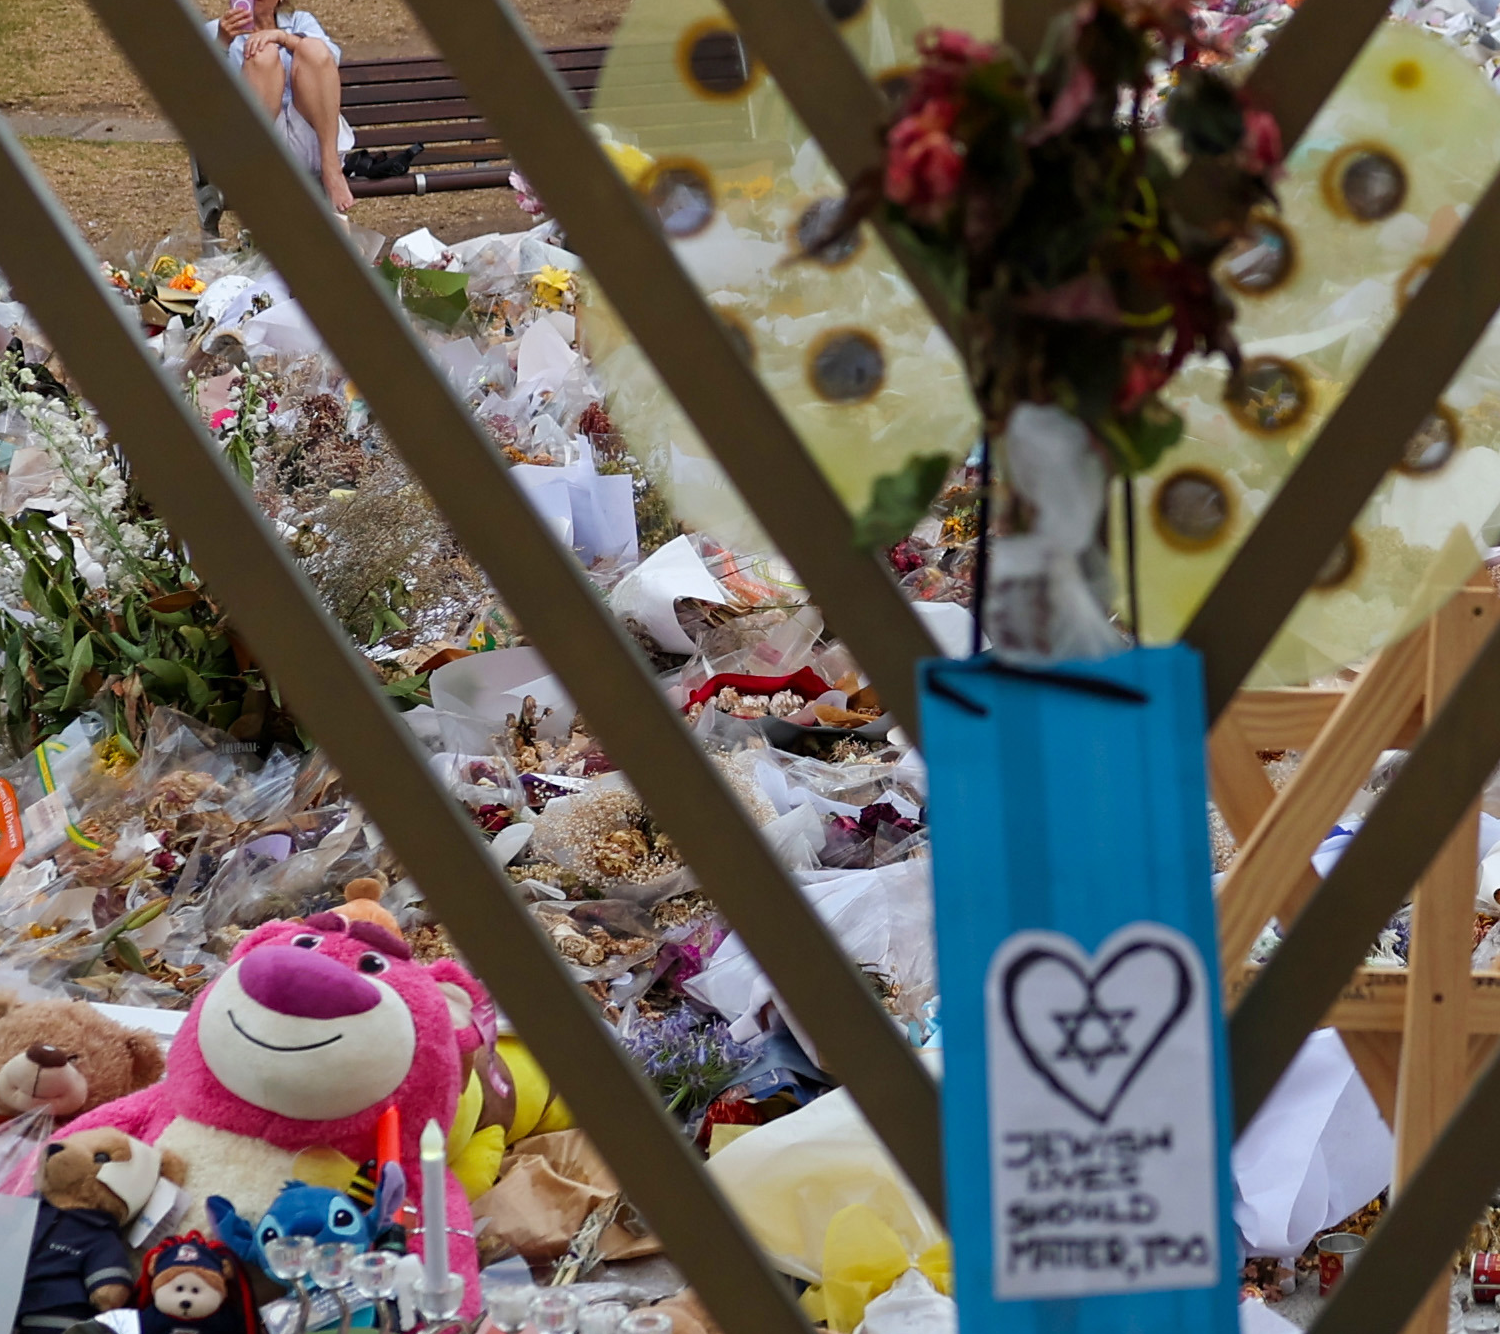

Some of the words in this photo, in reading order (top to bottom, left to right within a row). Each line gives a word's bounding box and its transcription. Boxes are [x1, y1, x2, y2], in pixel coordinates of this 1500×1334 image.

[2, 813, 18, 848] Flowers
[1004, 1124, 1174, 1170] JEWISH
[1027, 1164, 1140, 1195] LIVES
[1005, 1195, 1157, 1233] SHOULD
[1008, 1237, 1138, 1283] MATTER,
[1140, 1236, 1211, 1272] TOO
